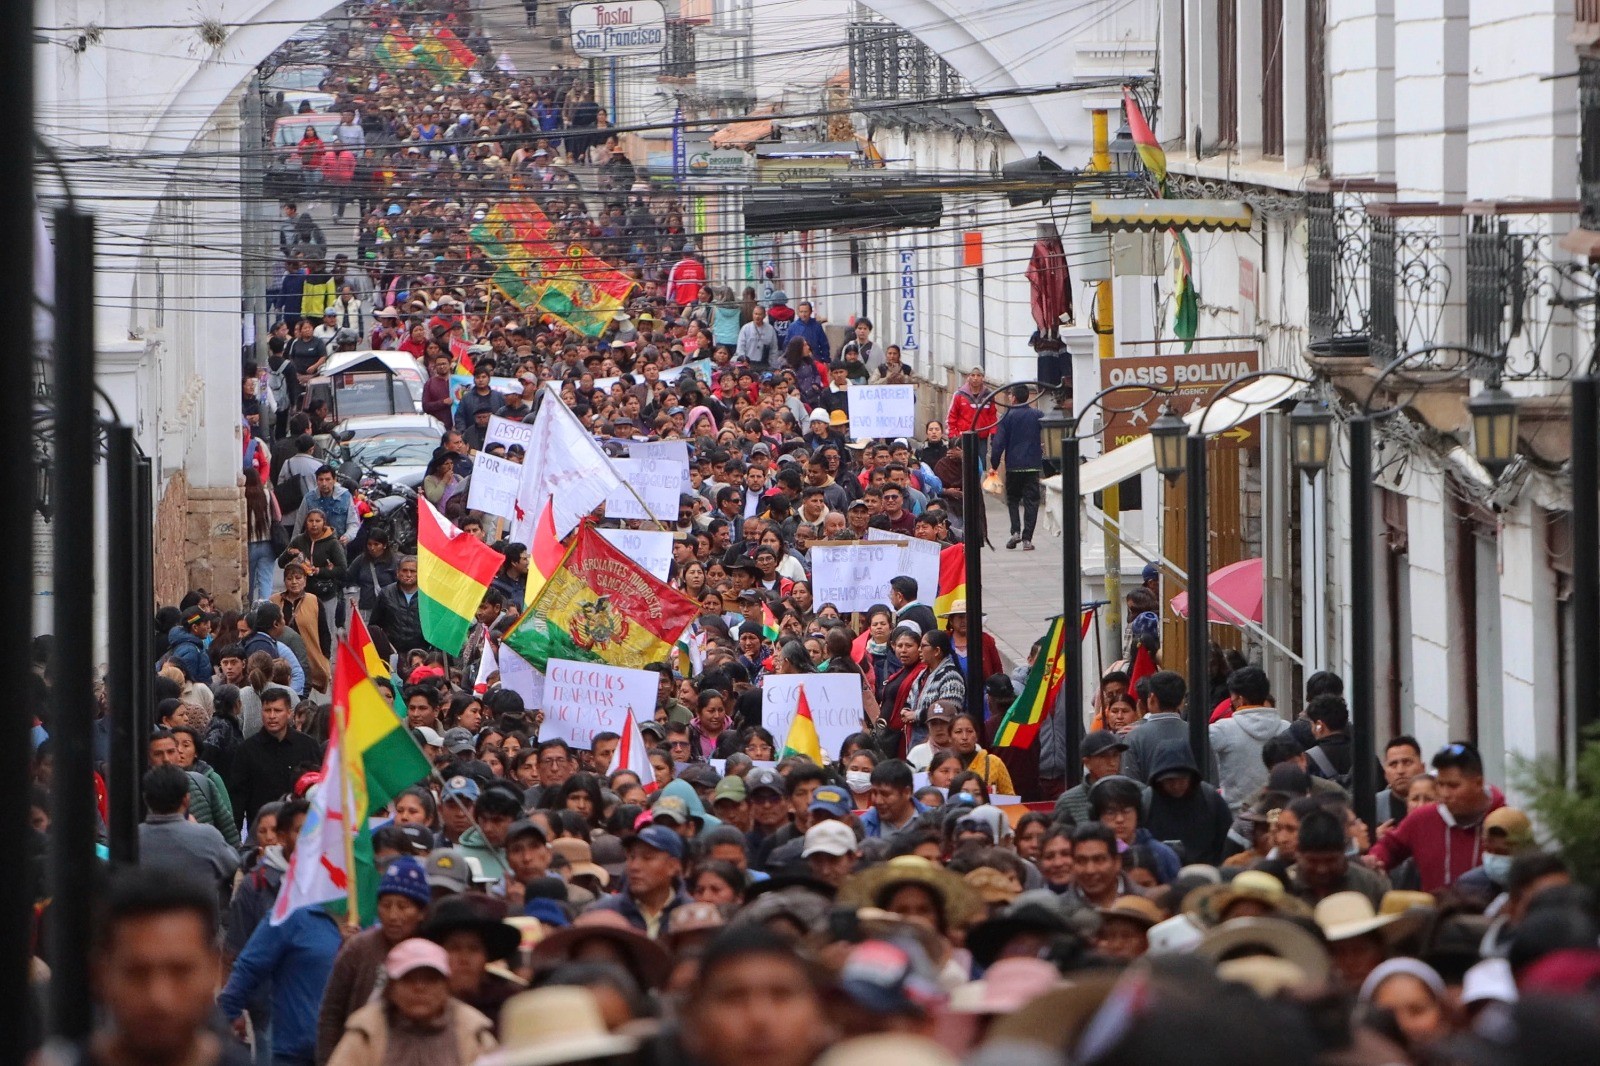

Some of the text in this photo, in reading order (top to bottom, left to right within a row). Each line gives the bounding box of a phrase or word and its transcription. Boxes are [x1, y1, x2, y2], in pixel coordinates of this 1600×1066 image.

[592, 5, 634, 29] Hostal
[576, 27, 662, 51] San Francisco
[901, 252, 917, 347] FARMACIA
[1109, 361, 1250, 386] OASIS BOLIVIA
[859, 388, 910, 401] AGARREN
[1179, 387, 1210, 396] AGENCY
[877, 401, 884, 413] A
[478, 457, 500, 473] POR
[623, 535, 642, 549] NO
[821, 547, 885, 563] RESPETO
[852, 566, 872, 581] LA
[820, 584, 890, 602] DEMOCRAC
